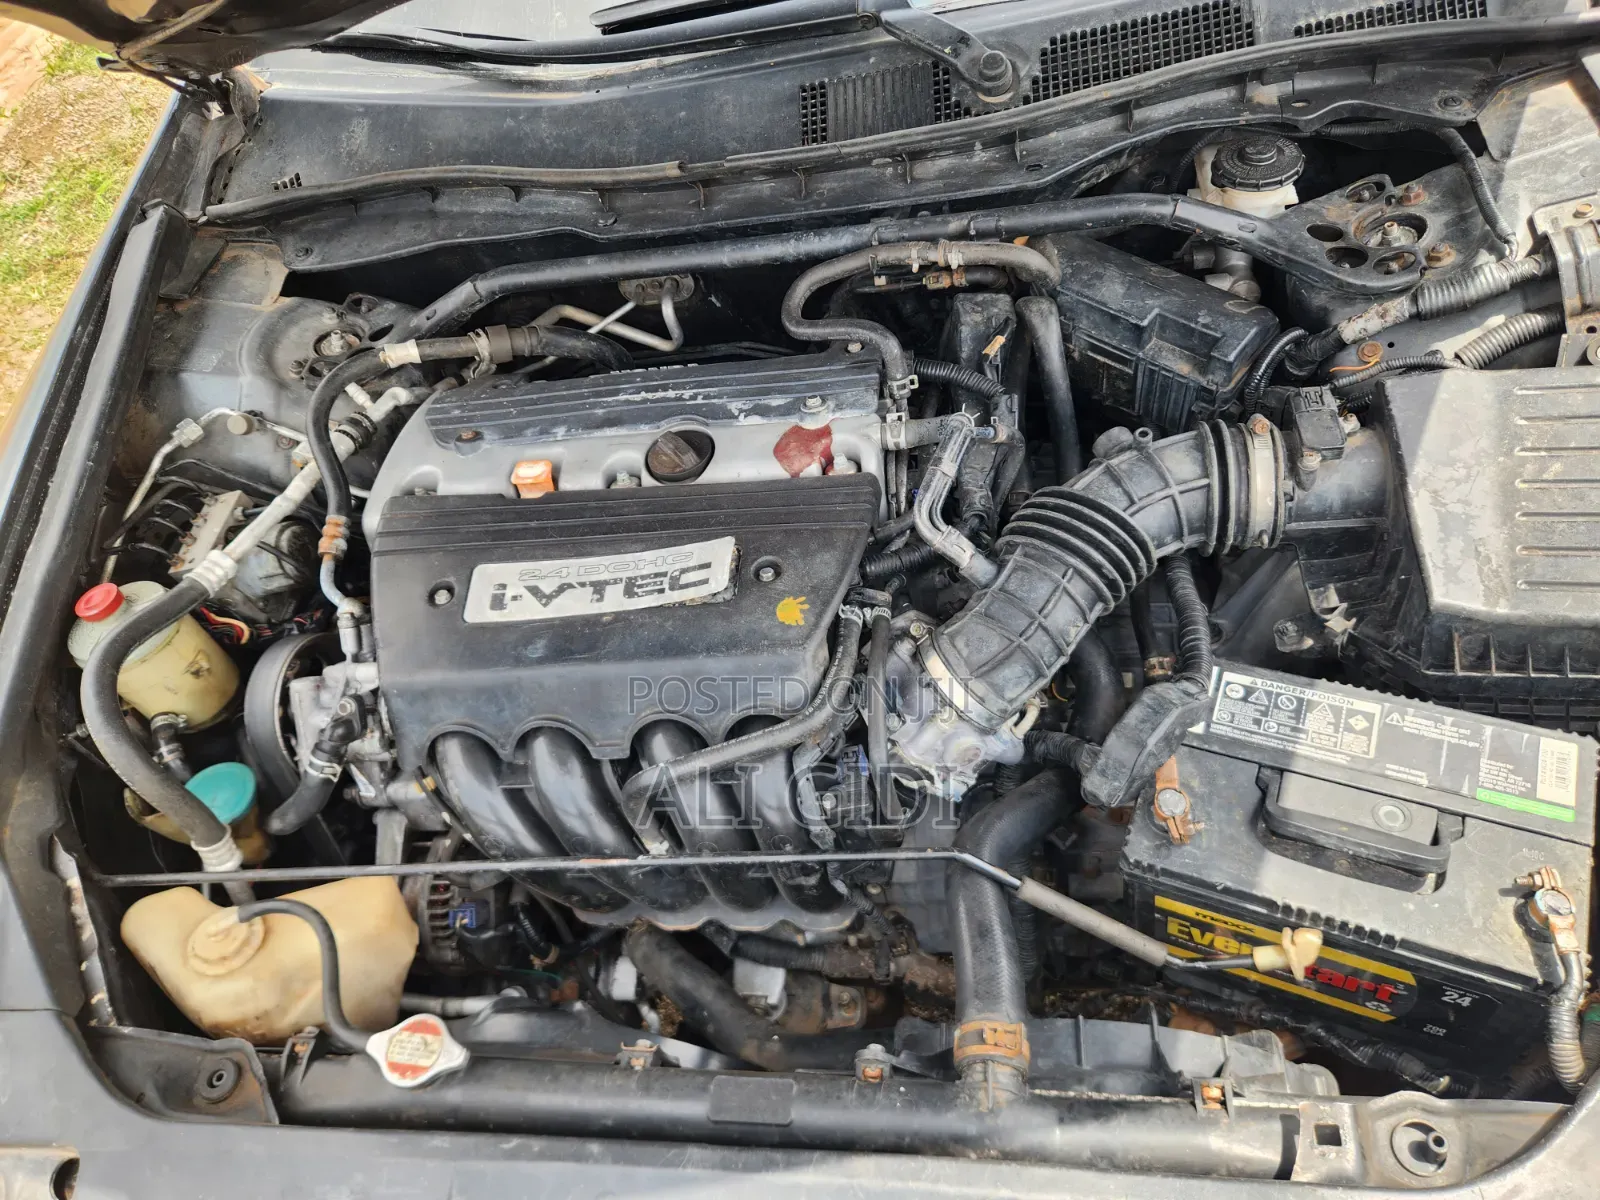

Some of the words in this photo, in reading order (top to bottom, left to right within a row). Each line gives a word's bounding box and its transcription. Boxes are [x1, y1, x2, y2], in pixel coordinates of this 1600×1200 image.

[518, 567, 571, 582] 2.4
[576, 551, 695, 577] DOHC
[488, 561, 713, 611] i-VTEC
[1261, 680, 1354, 707] DANGER/POISON
[1441, 991, 1473, 1007] 24
